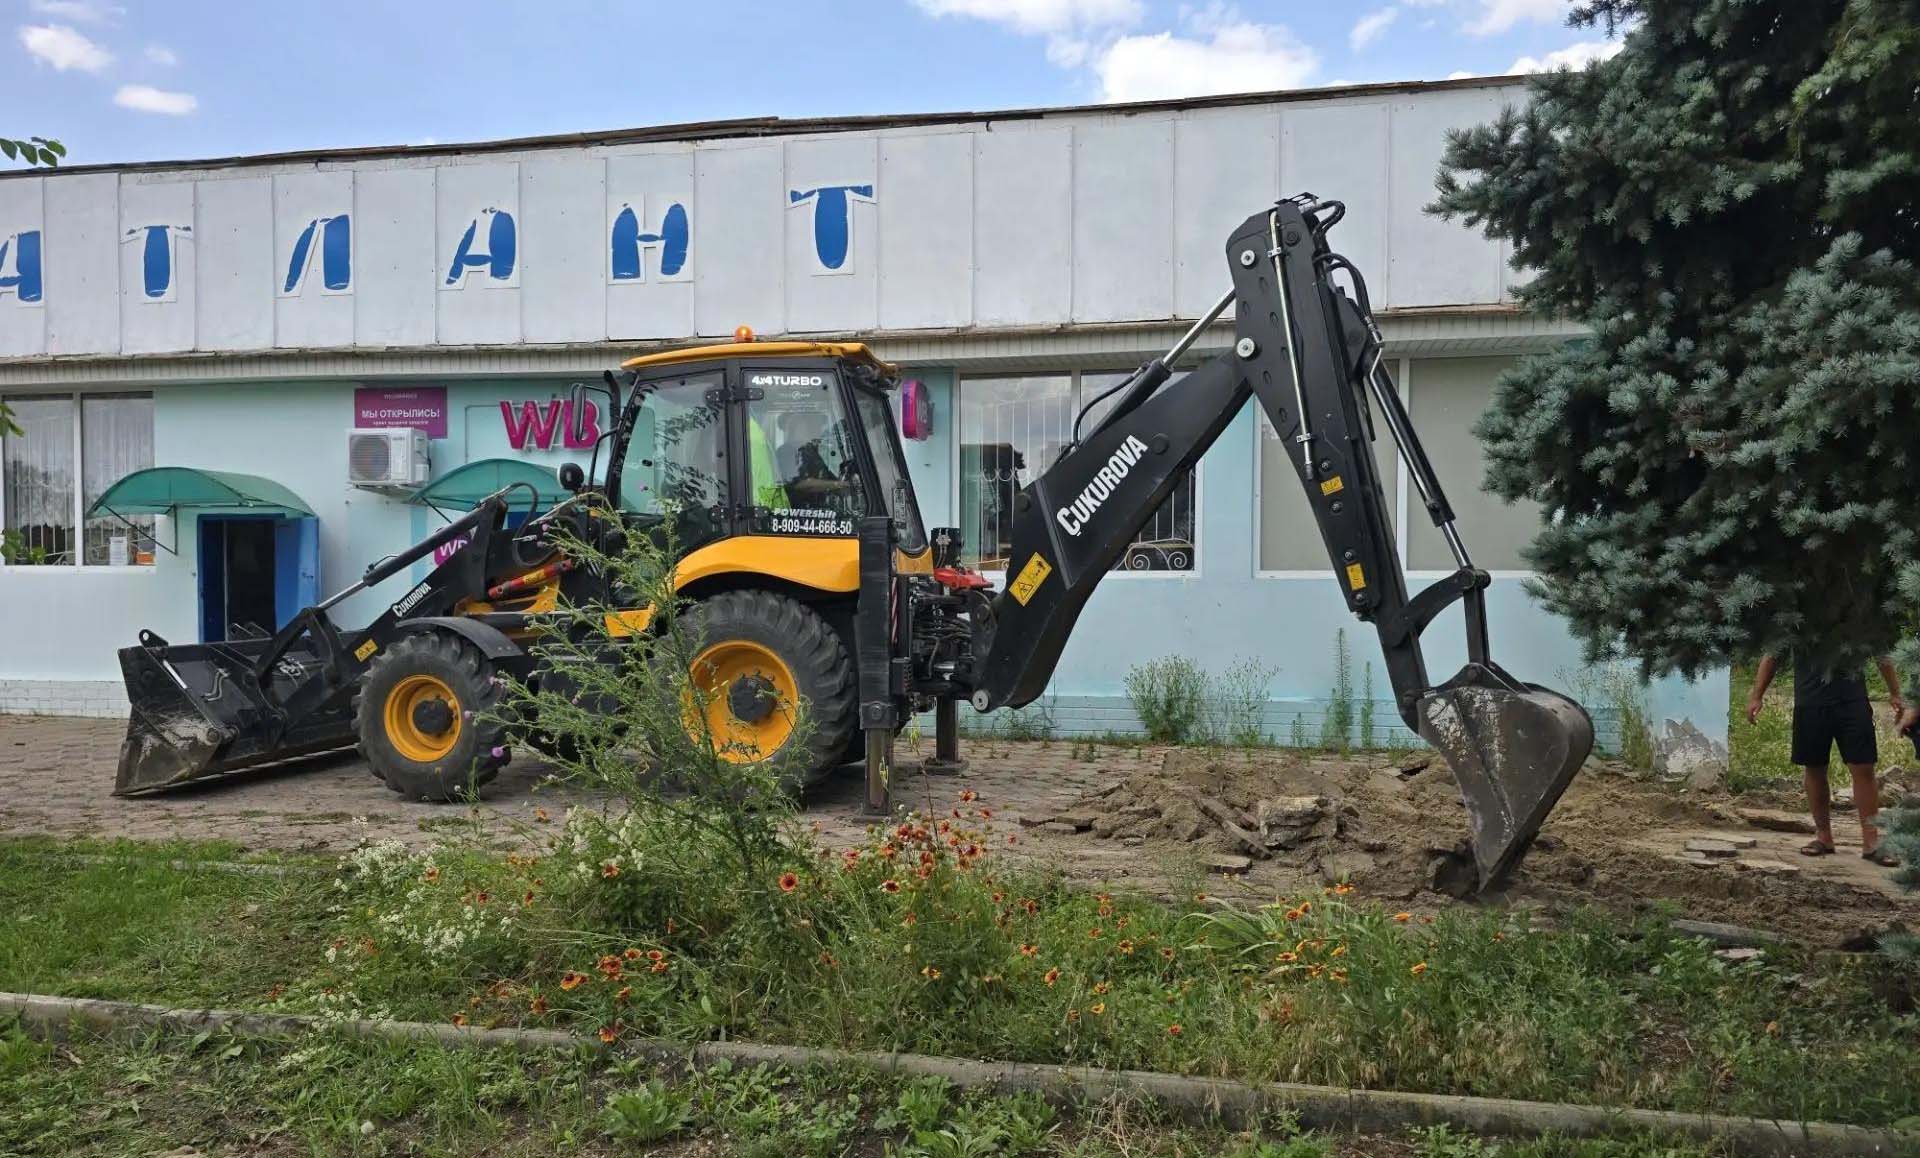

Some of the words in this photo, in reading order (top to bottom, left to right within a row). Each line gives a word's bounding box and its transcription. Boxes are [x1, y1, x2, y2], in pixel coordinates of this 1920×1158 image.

[361, 409, 378, 418] МЫ
[379, 408, 440, 418] ОТКРЫЛИСЬ!
[499, 399, 600, 450] WB
[1056, 434, 1149, 537] ÇUKUROVA
[772, 518, 852, 534] 8-909-44-666-50
